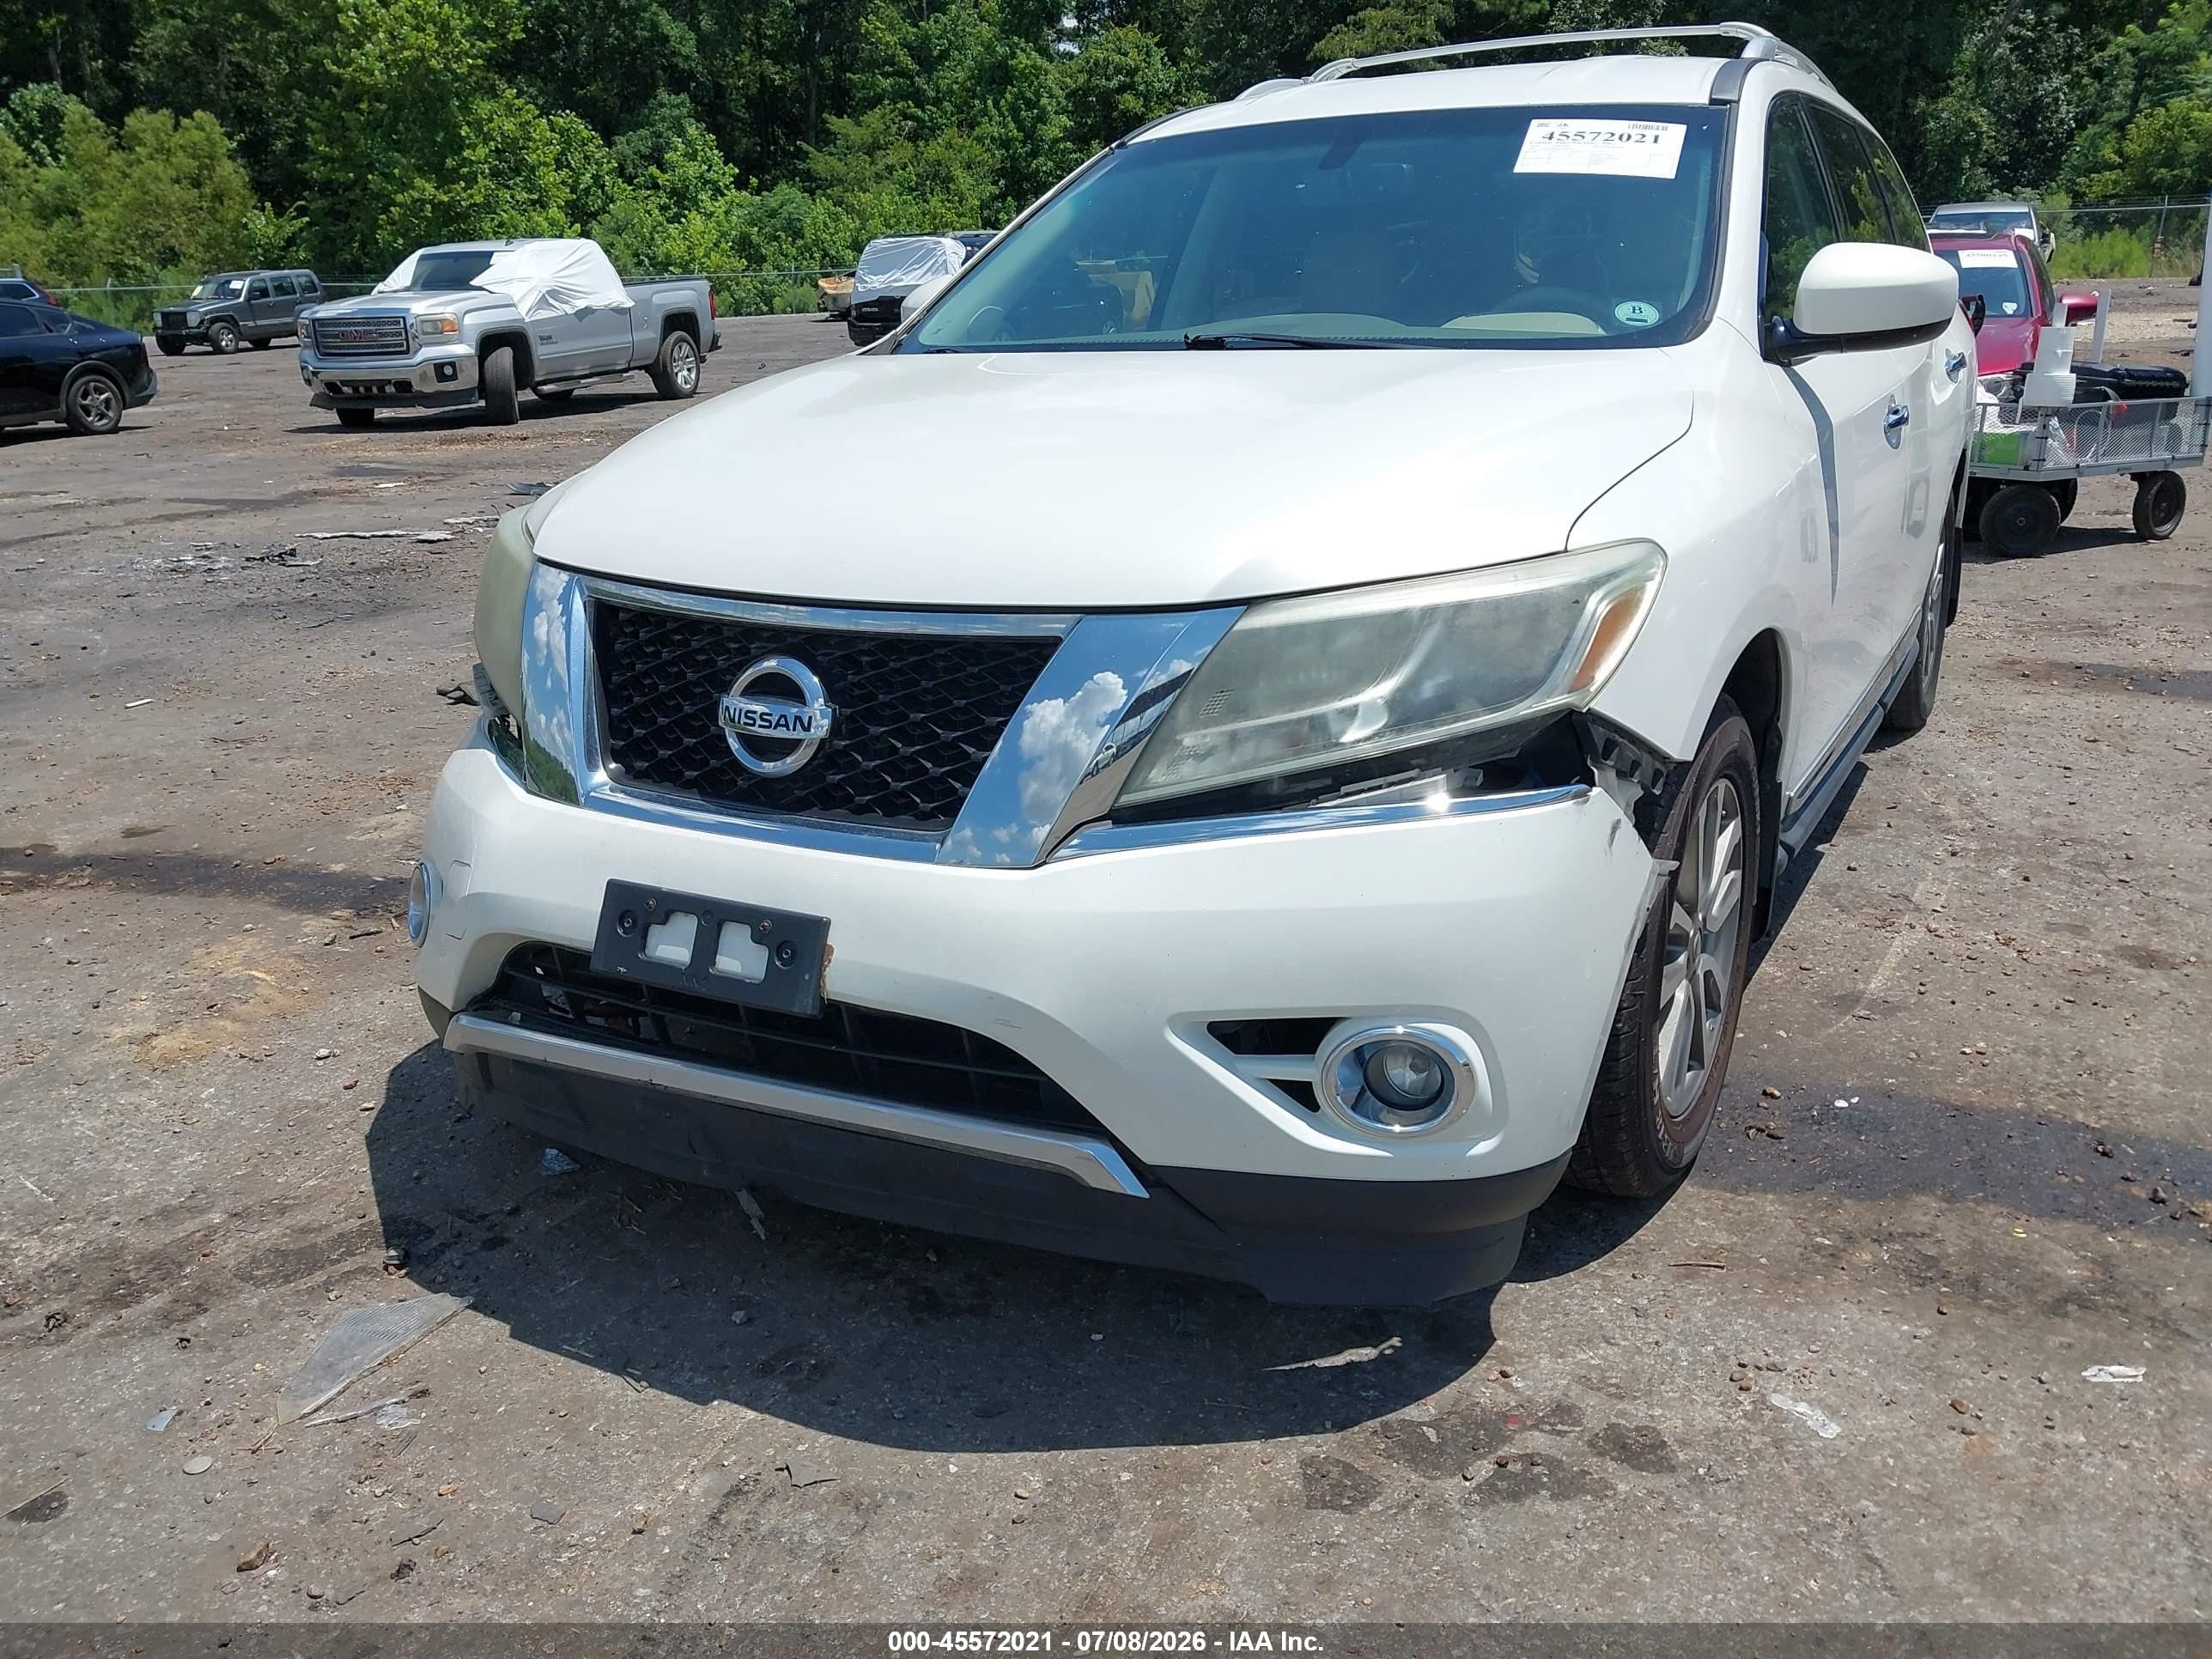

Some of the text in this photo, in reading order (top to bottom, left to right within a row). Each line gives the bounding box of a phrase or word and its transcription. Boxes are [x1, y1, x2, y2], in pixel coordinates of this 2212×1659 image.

[1541, 131, 1661, 143] 45572021
[1632, 306, 1644, 314] B
[723, 706, 812, 732] NISSAN
